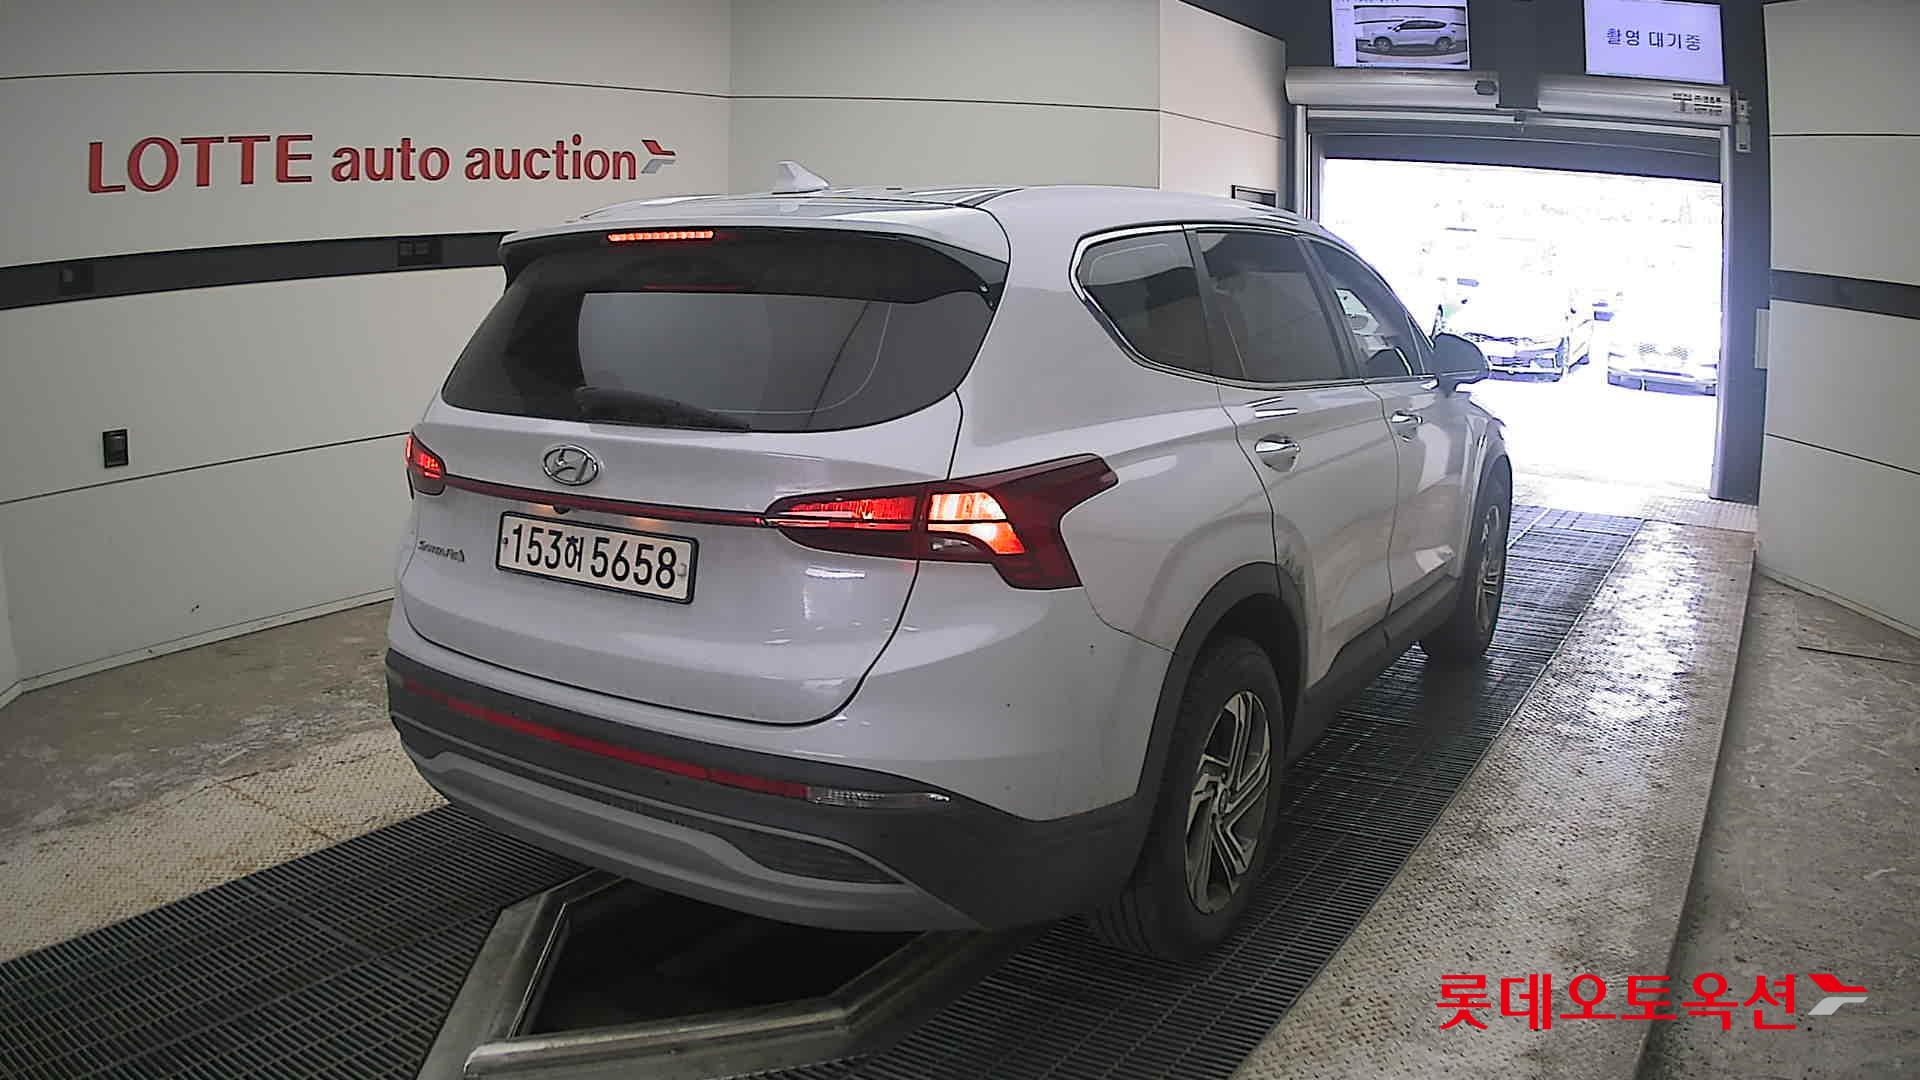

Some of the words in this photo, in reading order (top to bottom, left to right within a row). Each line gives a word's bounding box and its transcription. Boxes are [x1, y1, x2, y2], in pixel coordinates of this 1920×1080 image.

[1648, 31, 1701, 51] 대기중
[88, 134, 313, 193] LOTTE
[331, 137, 450, 182] auto
[464, 133, 637, 181] auction
